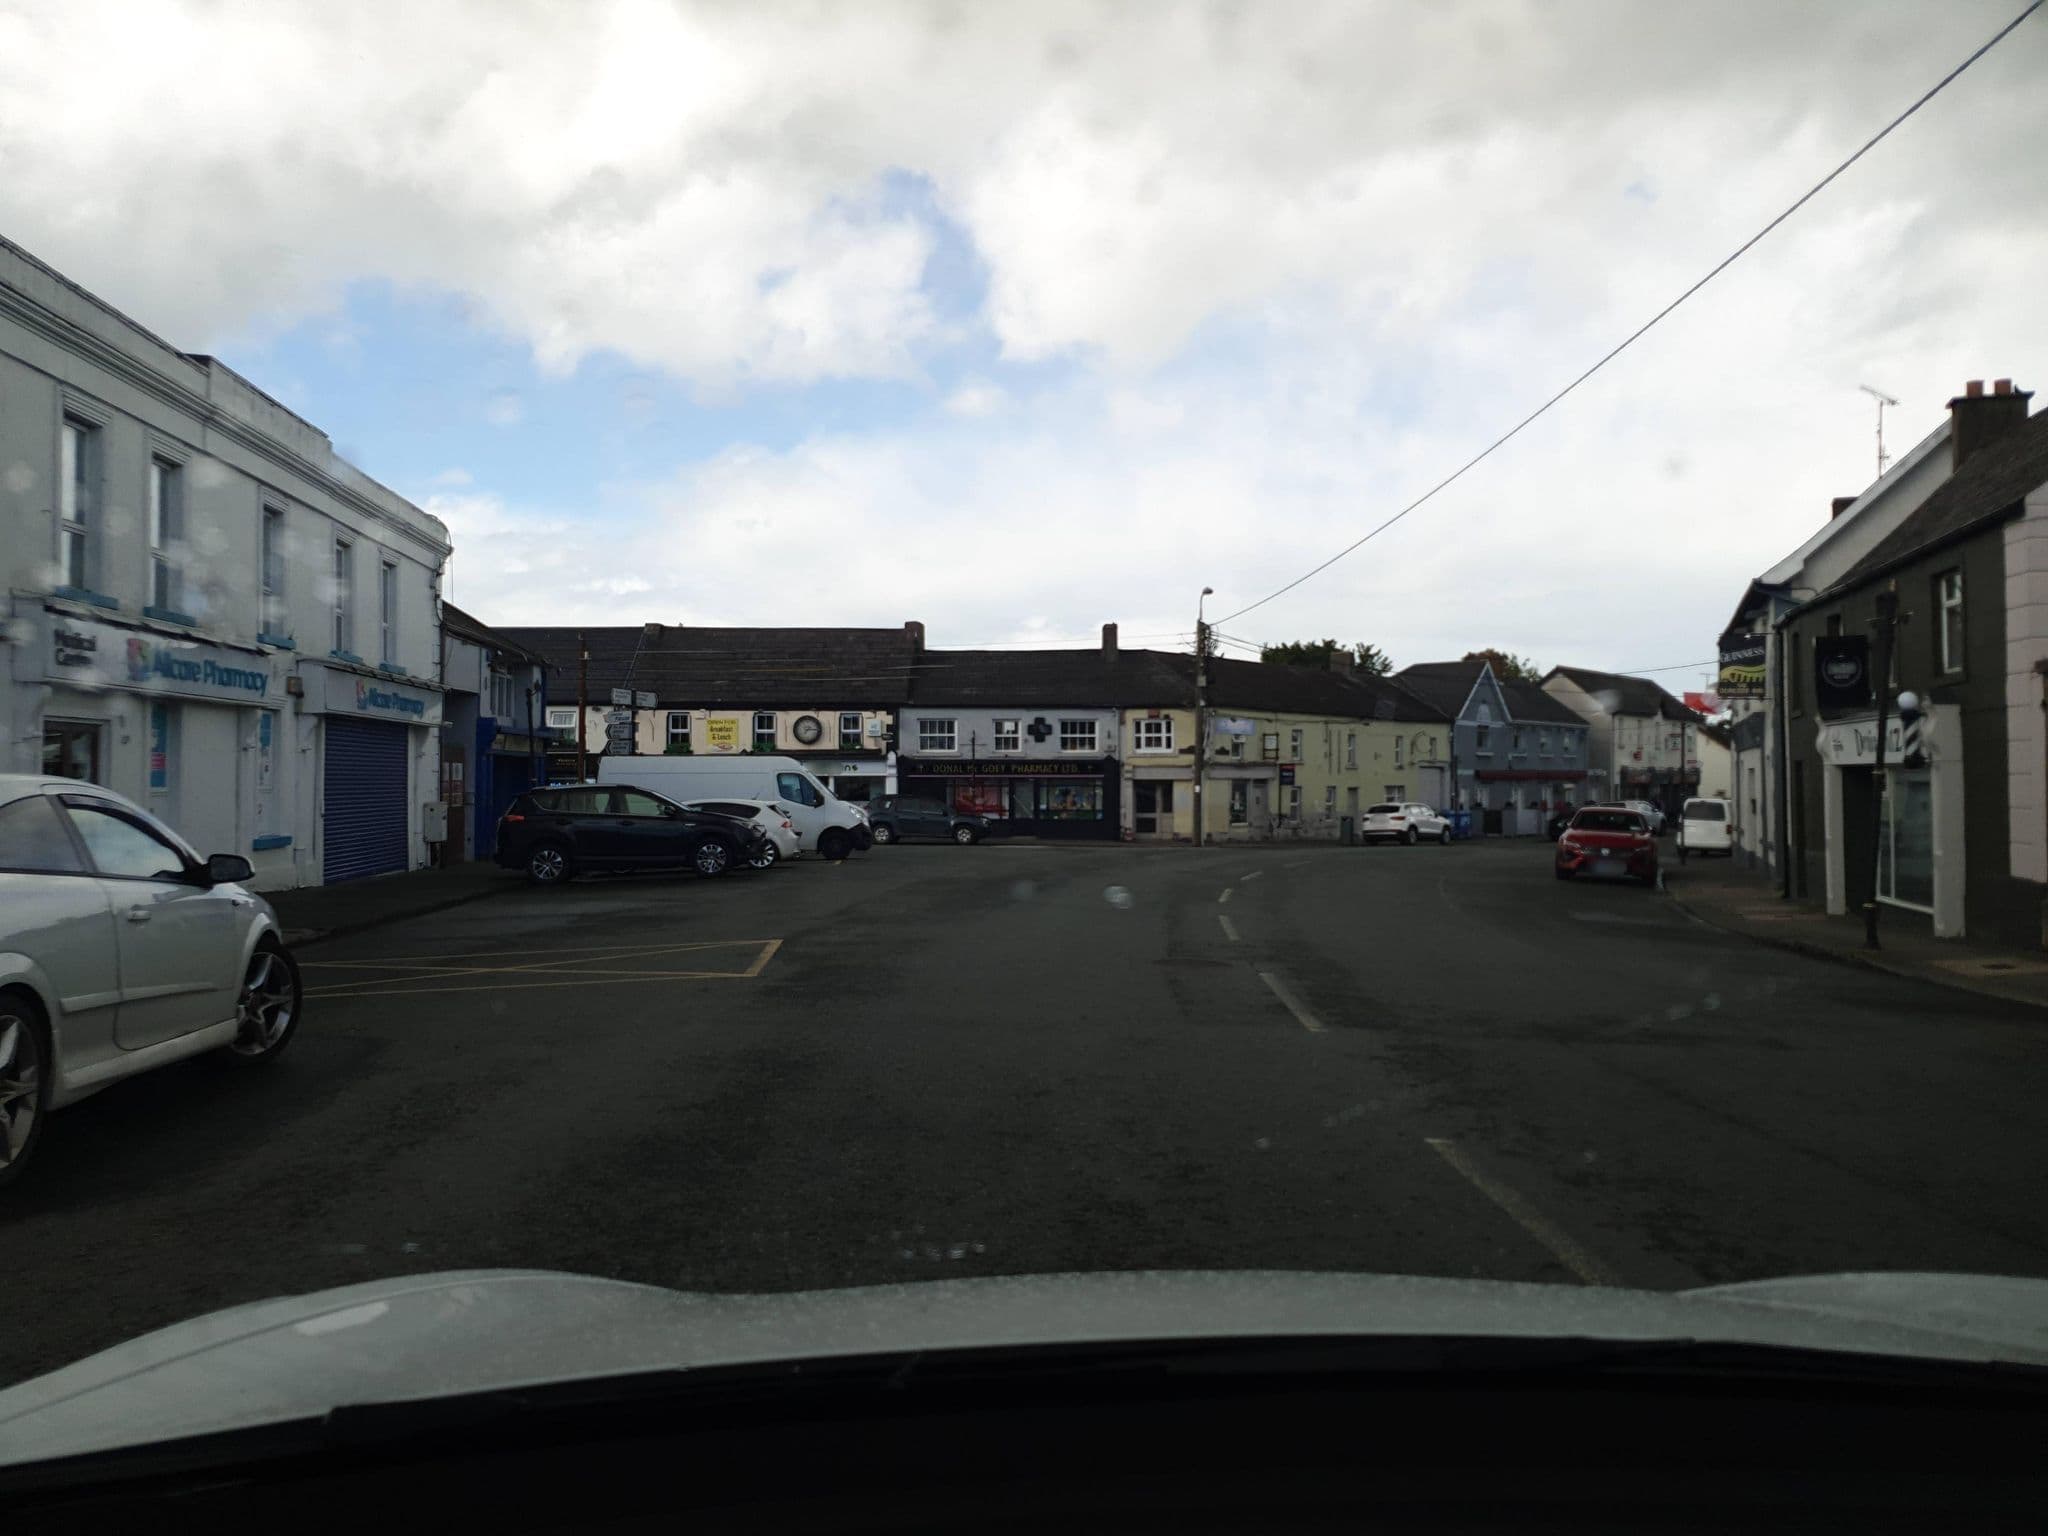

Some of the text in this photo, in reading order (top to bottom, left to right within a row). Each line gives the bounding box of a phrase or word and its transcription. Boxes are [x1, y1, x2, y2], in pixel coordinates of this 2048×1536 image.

[153, 649, 269, 697] Allcare Pharmacy
[392, 692, 425, 719] Pharmacy
[1011, 763, 1059, 774] PHARMACY
